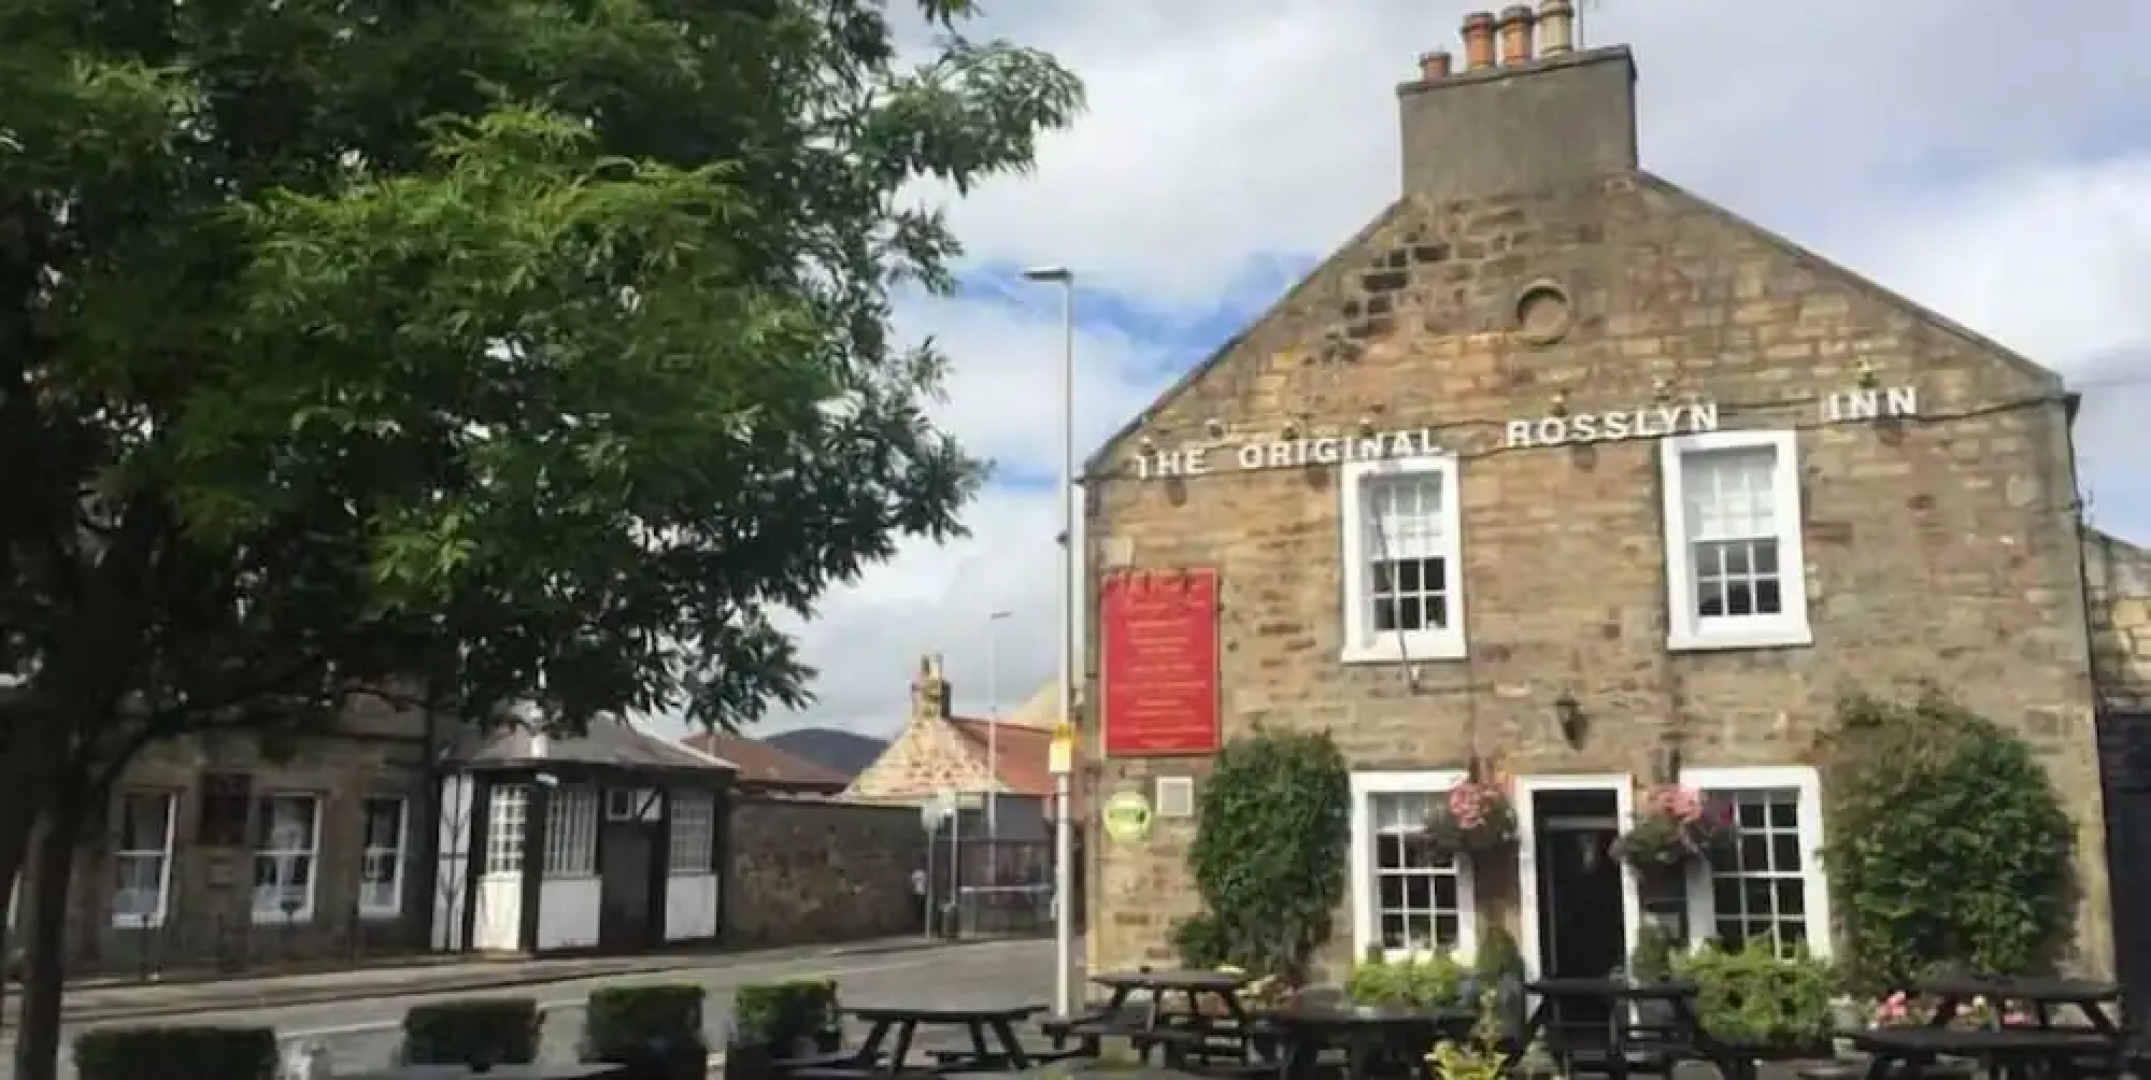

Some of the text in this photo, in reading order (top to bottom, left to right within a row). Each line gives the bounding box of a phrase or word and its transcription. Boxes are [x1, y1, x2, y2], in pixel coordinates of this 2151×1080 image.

[1134, 385, 1918, 479] THE ORIGINAL ROSSLYN INN
